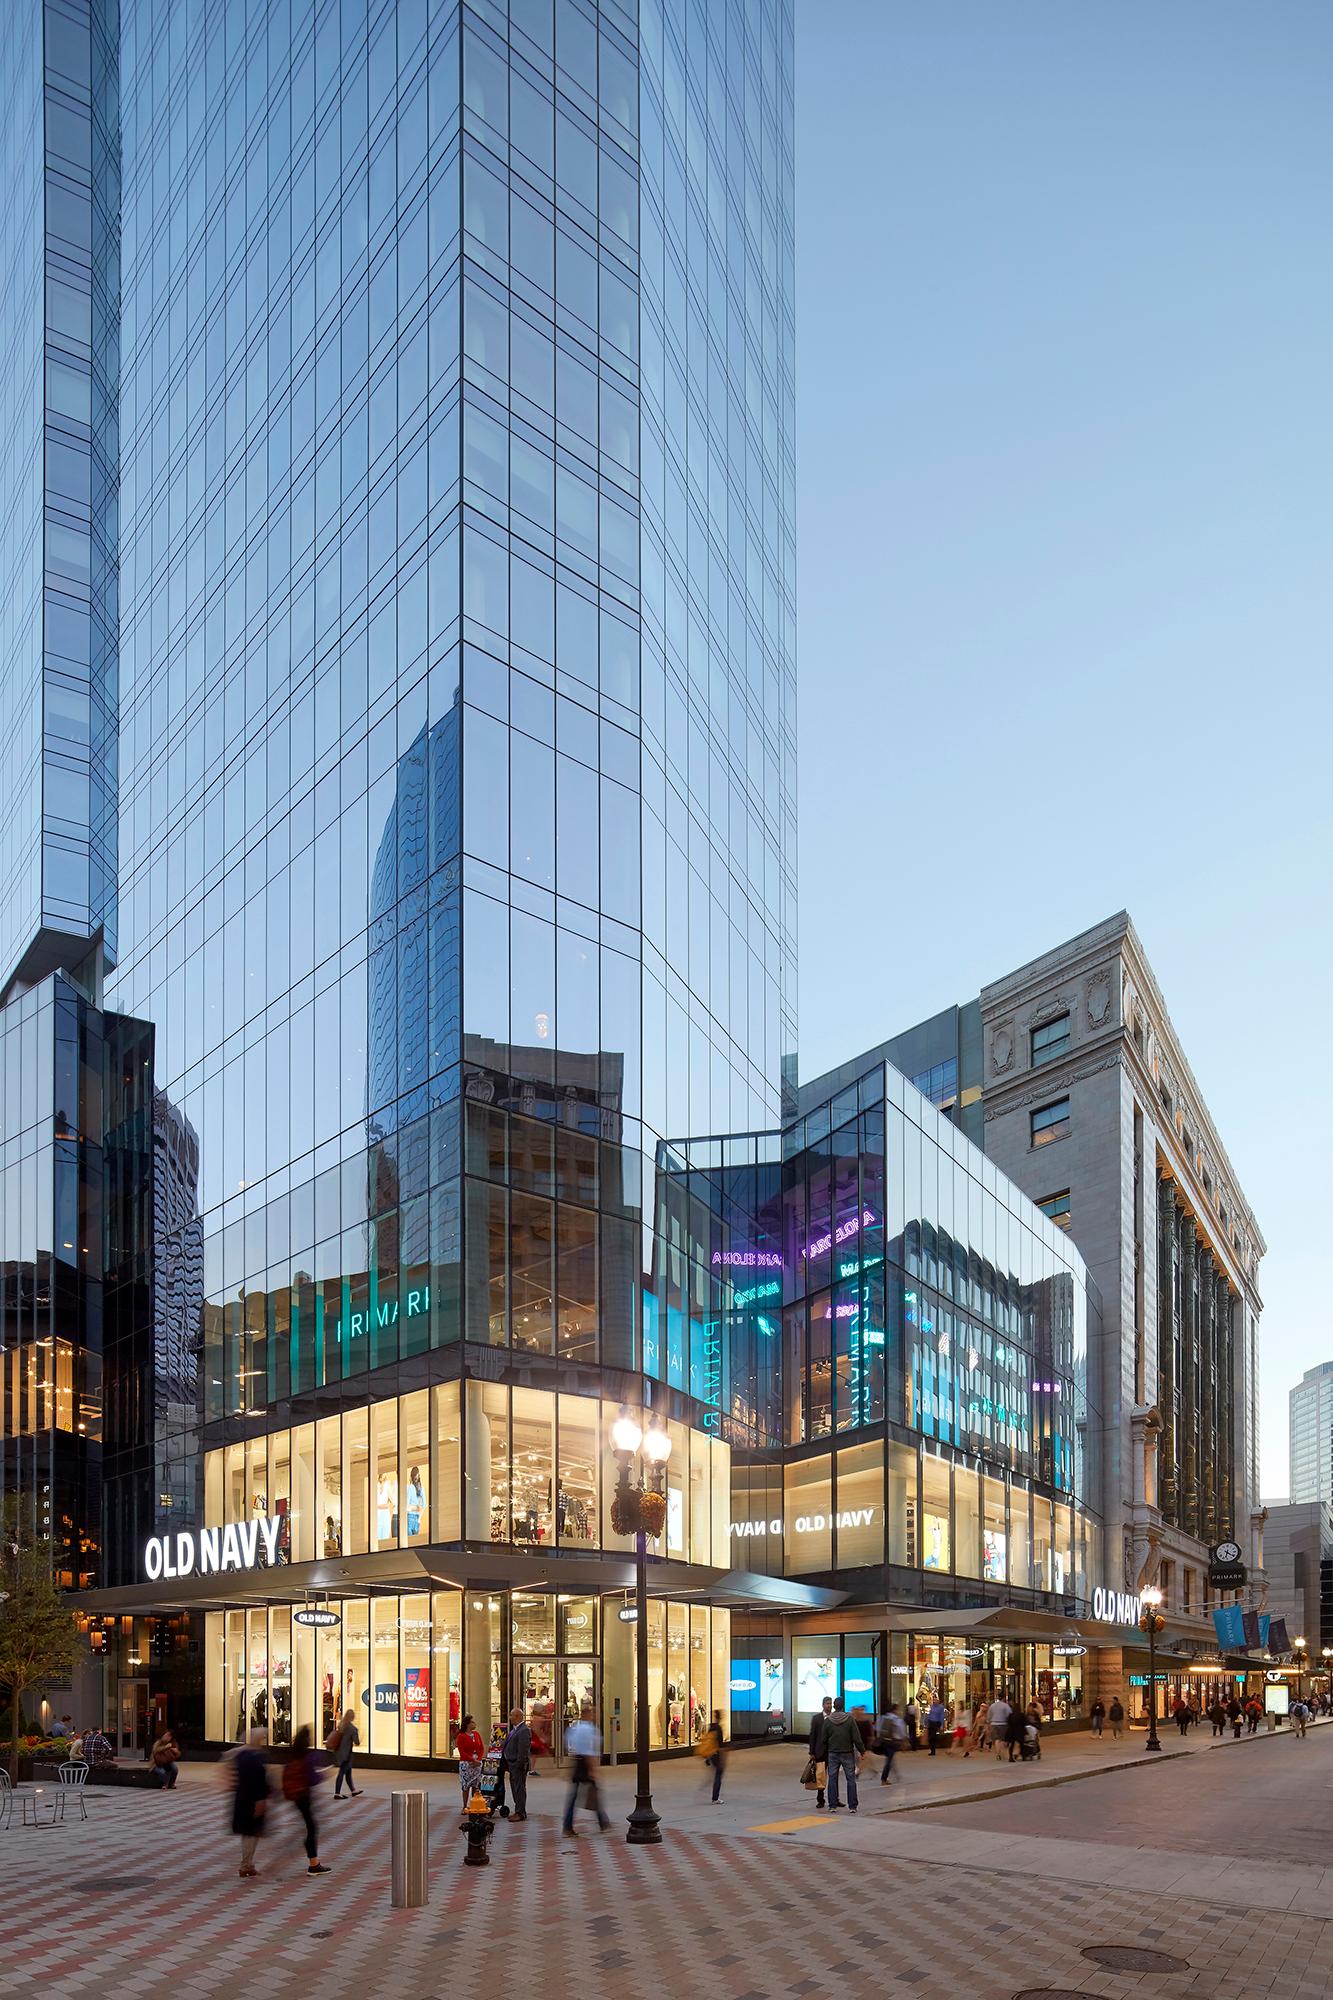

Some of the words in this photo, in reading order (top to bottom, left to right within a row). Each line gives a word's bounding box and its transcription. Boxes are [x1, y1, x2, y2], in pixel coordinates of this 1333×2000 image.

[795, 1515, 825, 1533] OLD
[829, 1509, 873, 1530] NAVY
[145, 1532, 195, 1580] OLD
[200, 1514, 281, 1573] NAVY
[1094, 1586, 1116, 1622] OLD
[1116, 1592, 1143, 1627] NAVY
[299, 1613, 314, 1622] OLD
[315, 1614, 336, 1624] NAVY
[1269, 1672, 1279, 1680] T
[385, 1692, 399, 1704] NA
